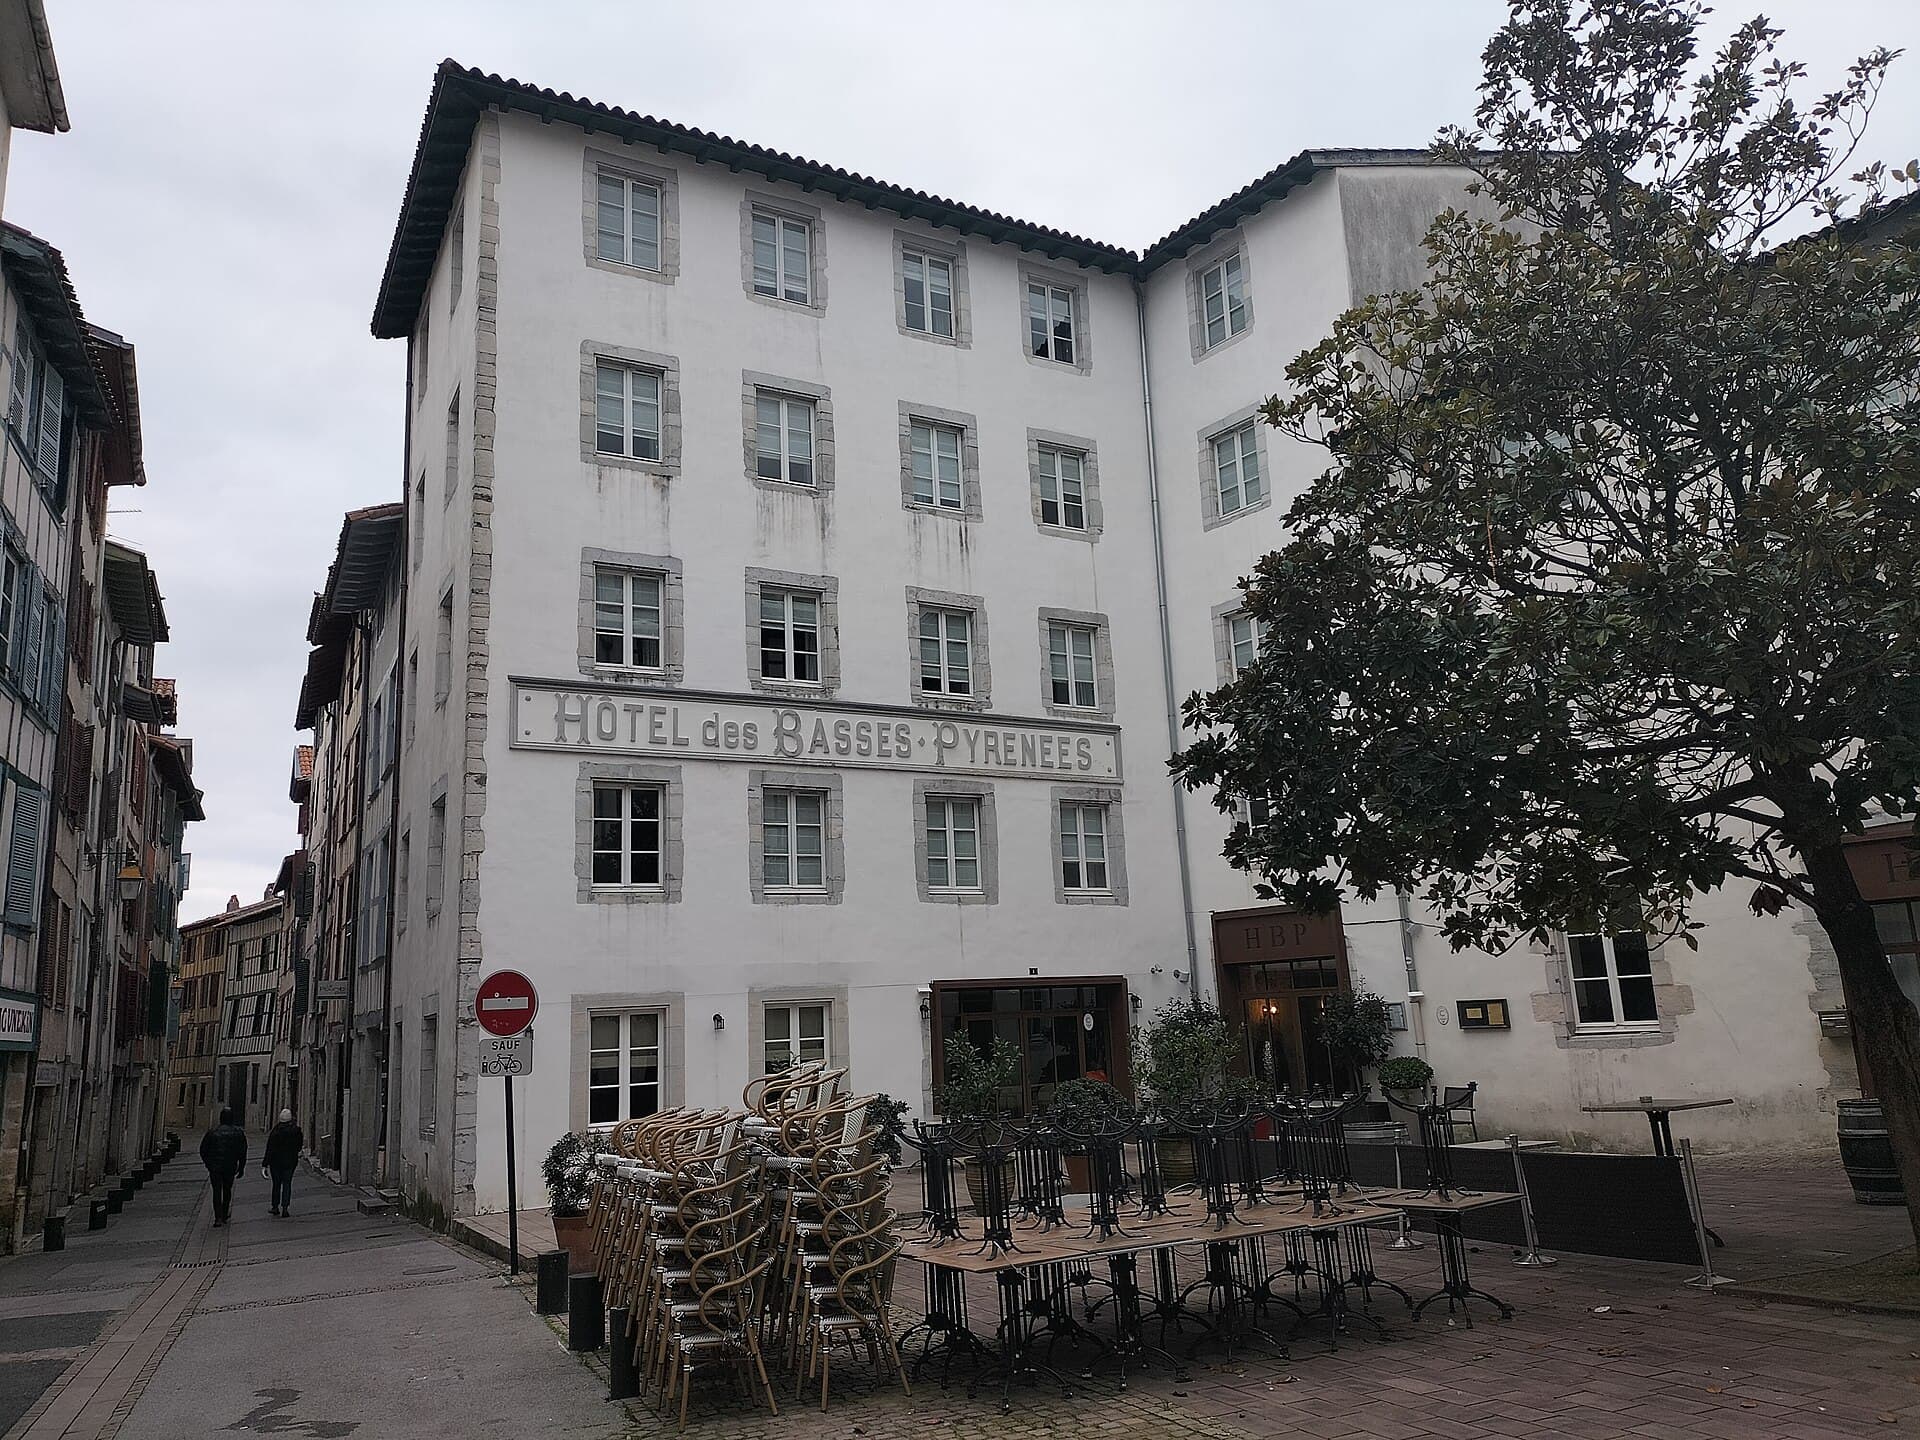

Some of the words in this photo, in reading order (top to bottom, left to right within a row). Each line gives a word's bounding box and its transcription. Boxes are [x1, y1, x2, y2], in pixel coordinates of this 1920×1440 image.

[554, 693, 689, 745] HÔTEL
[702, 712, 758, 749] des
[772, 709, 911, 758] BASSES
[932, 722, 1093, 771] PYRENEES
[491, 1040, 520, 1051] SAUF
